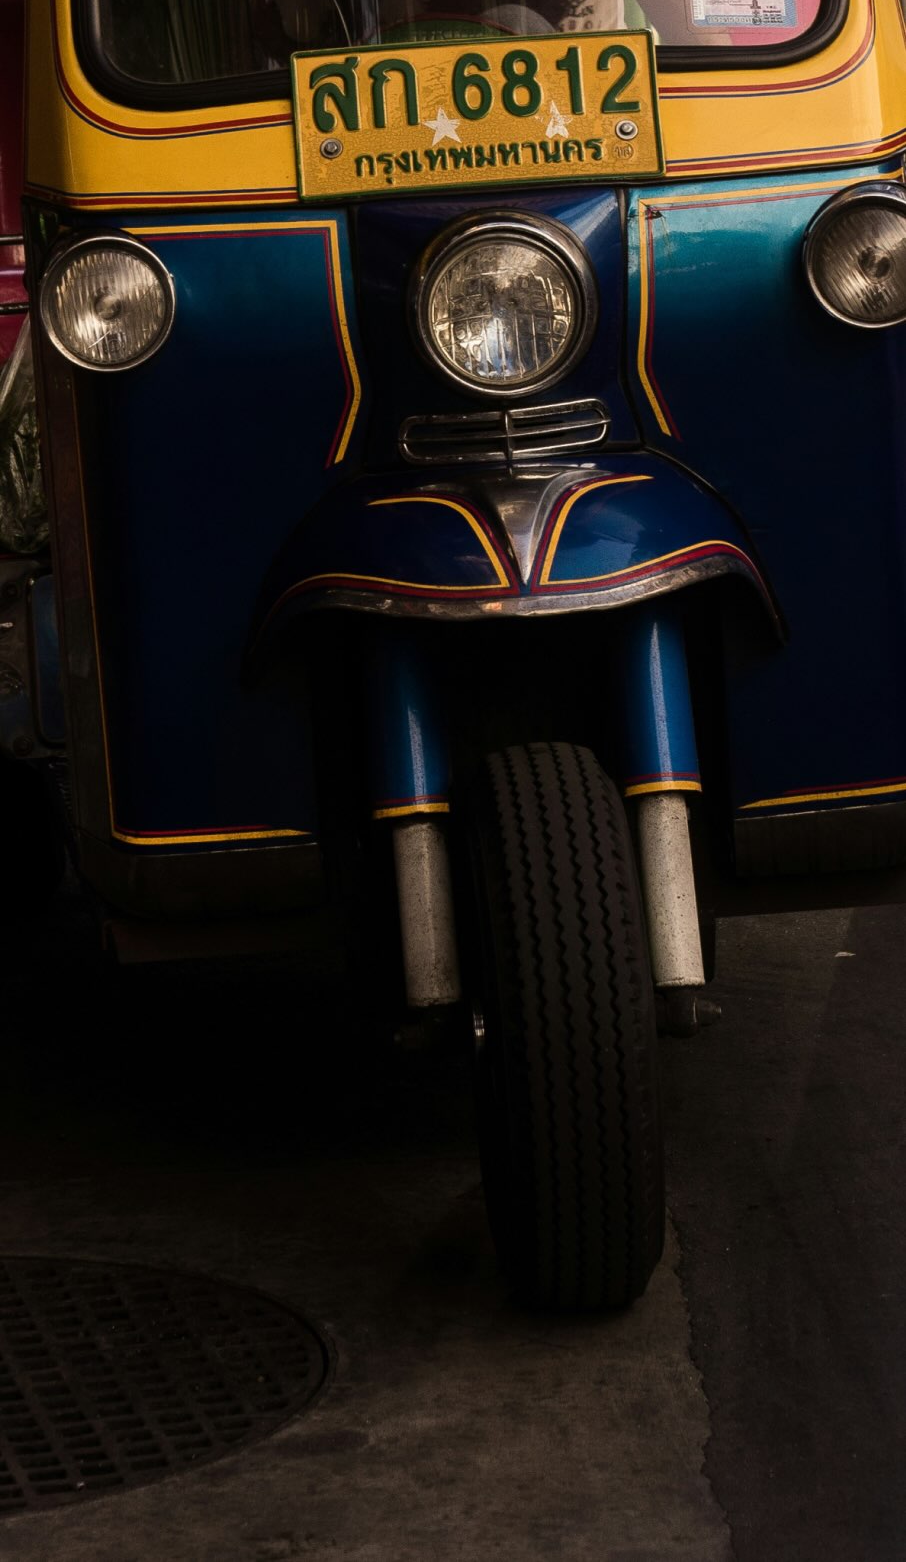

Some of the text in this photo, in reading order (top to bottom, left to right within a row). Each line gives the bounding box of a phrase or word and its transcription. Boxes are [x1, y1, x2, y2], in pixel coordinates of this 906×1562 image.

[309, 44, 642, 134] สก 6812
[355, 137, 604, 184] กรุงเทพมหานคร
